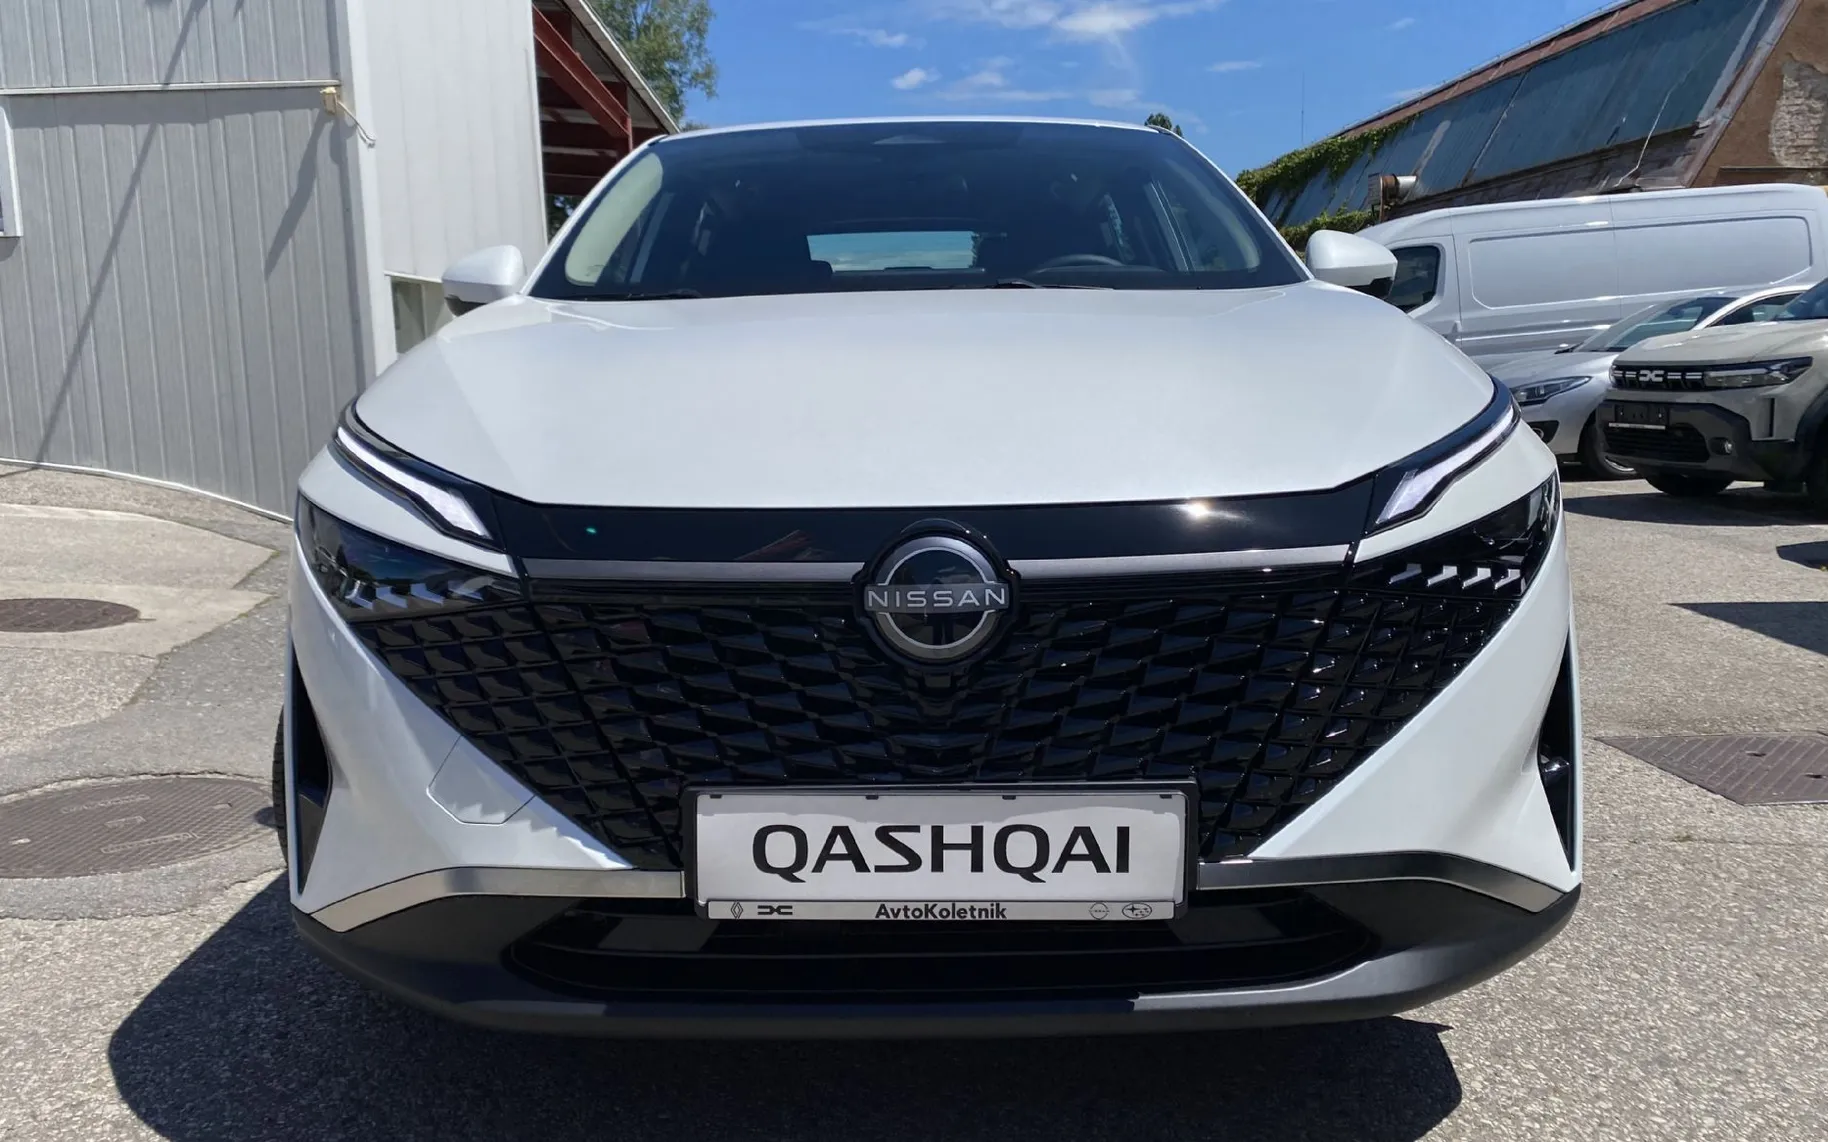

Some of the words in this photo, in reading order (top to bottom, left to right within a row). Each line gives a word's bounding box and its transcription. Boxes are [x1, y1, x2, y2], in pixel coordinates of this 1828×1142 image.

[868, 588, 1005, 607] NISSAN
[753, 824, 1129, 883] QASHQAI
[875, 902, 1007, 919] AvtoKoletnik
